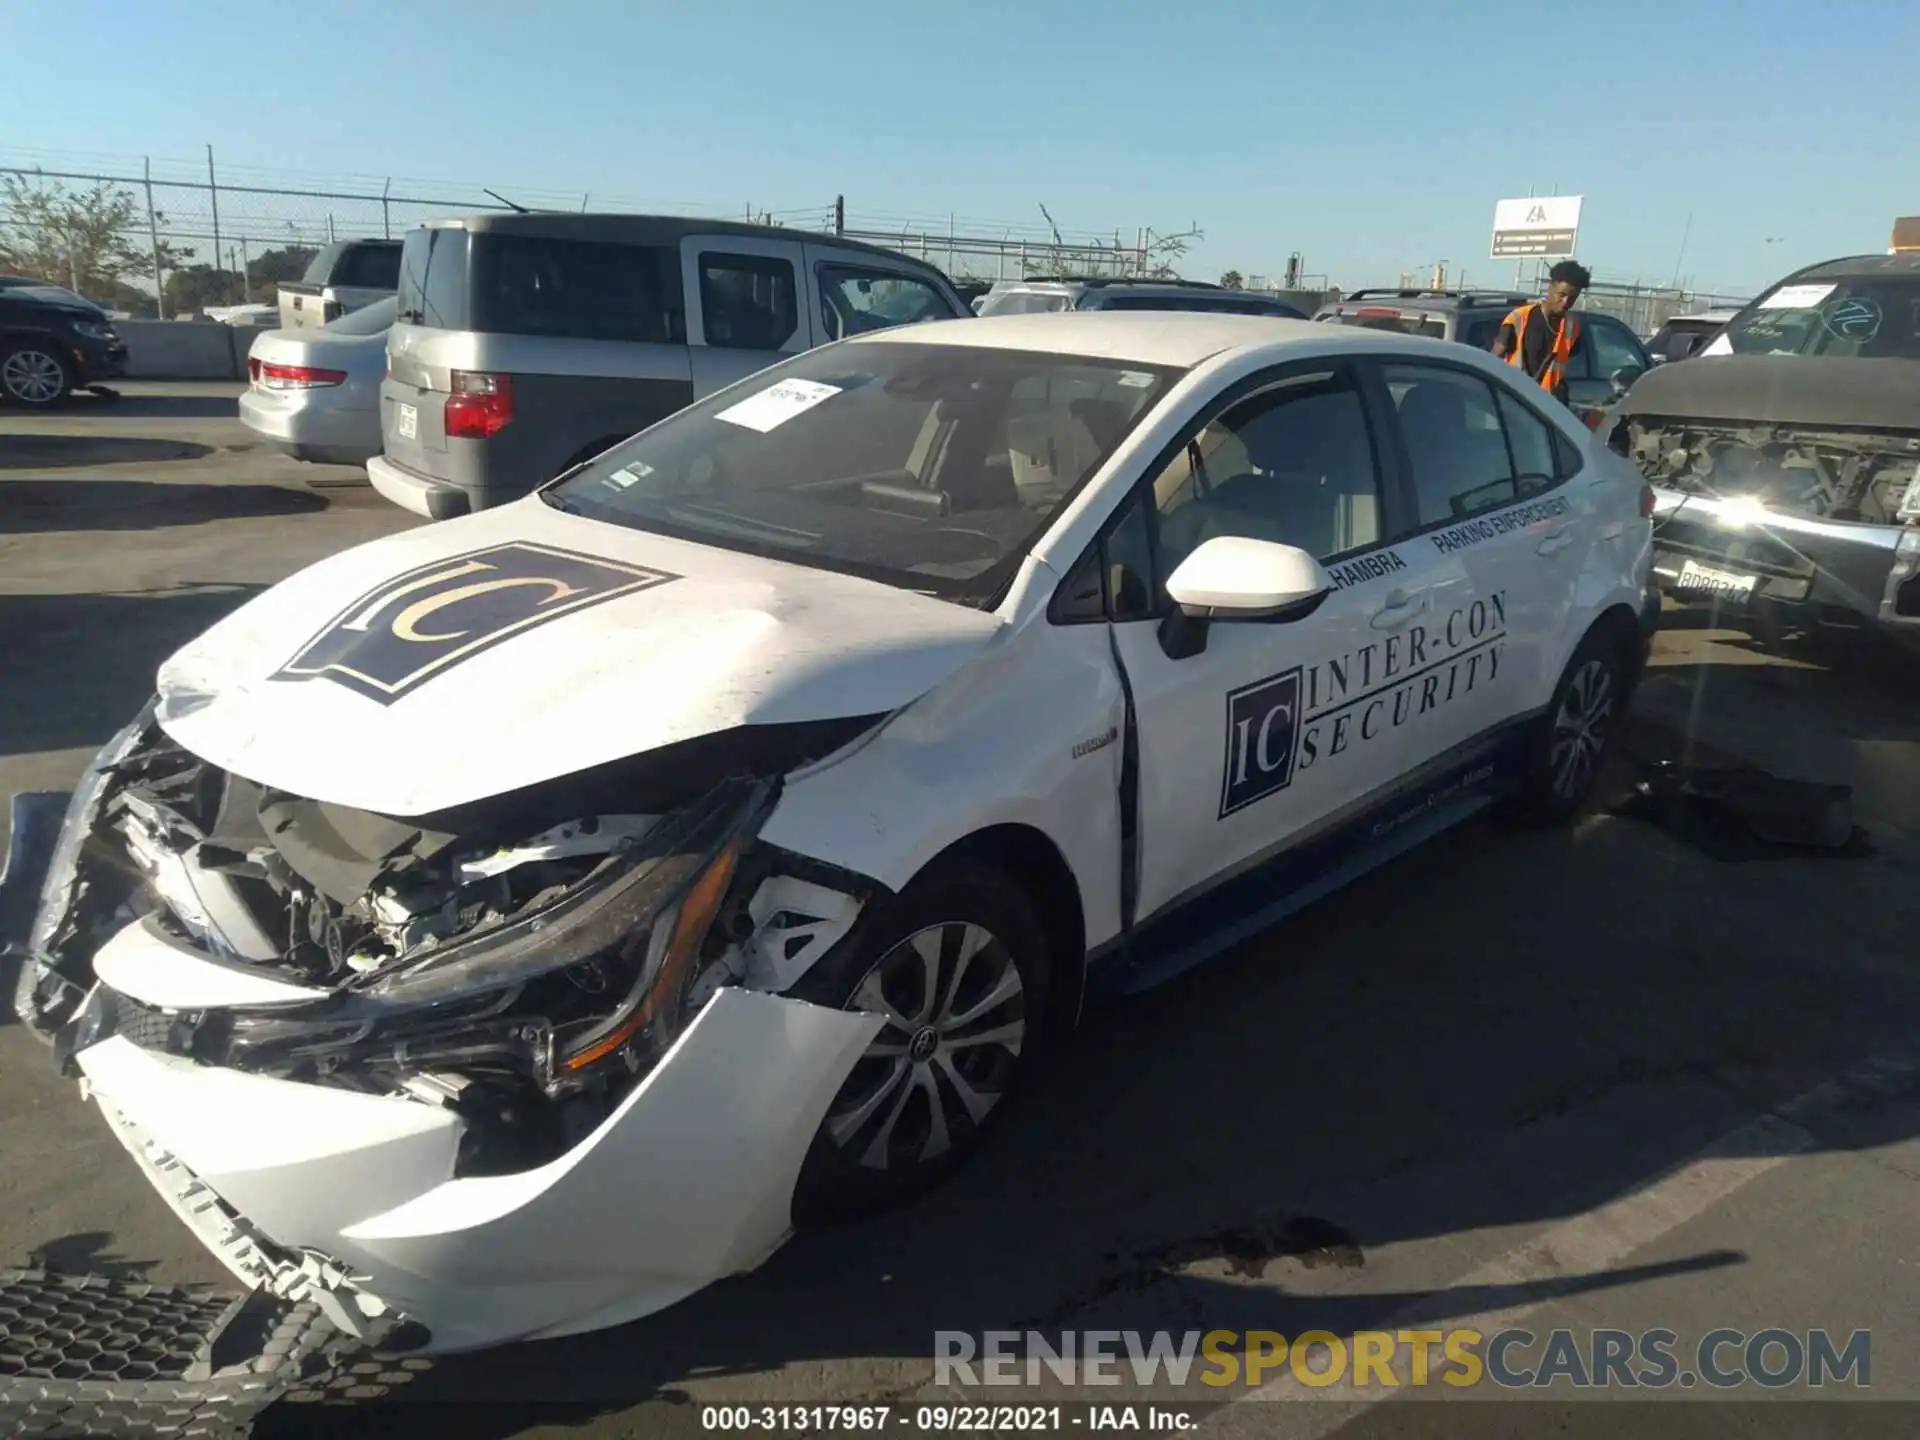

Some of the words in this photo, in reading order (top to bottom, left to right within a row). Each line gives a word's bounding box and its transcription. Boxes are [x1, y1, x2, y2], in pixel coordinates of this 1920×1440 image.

[1327, 551, 1407, 591] HAMBRA
[1431, 520, 1494, 555] PARKING
[1489, 496, 1572, 534] ENFORCEMENT
[342, 560, 587, 642] IC
[1304, 590, 1506, 711] INTER-CON
[1232, 700, 1292, 787] IC
[1300, 643, 1506, 770] SECURITY
